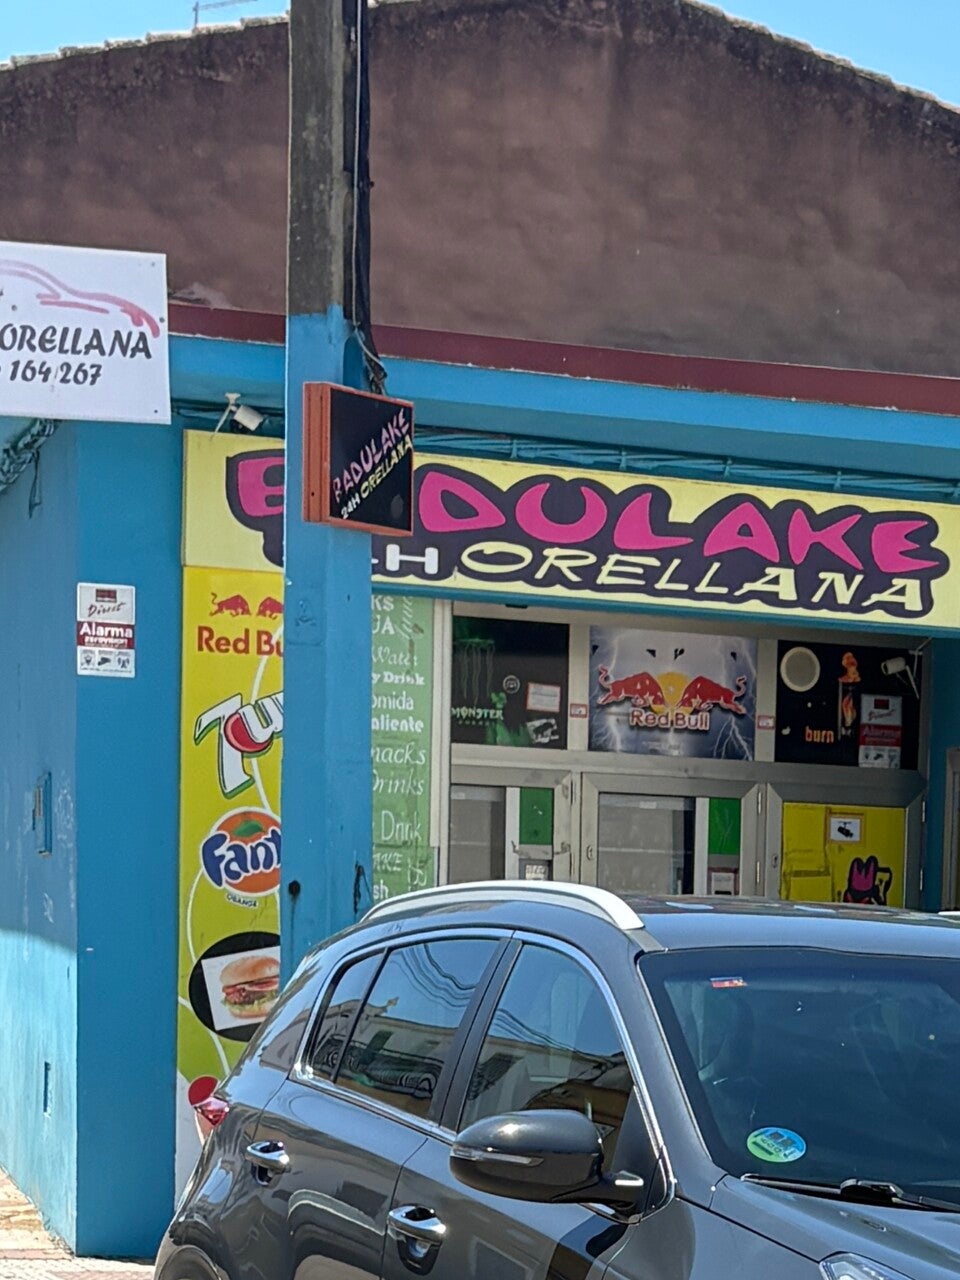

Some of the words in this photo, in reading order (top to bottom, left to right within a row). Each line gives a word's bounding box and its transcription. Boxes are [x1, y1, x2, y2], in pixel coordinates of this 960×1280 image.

[0, 323, 152, 359] ORELLANA
[10, 360, 52, 383] 164
[59, 362, 102, 385] 267
[341, 493, 360, 519] 24H
[360, 434, 413, 499] ORELLANA
[236, 456, 941, 573] BDULAKE
[460, 541, 922, 611] ORELLANA
[80, 622, 133, 638] Alarma
[197, 626, 250, 654] Red
[383, 671, 425, 685] Drink
[371, 691, 414, 710] omida
[371, 714, 424, 732] aliente
[630, 709, 669, 727] Red
[674, 711, 710, 729] Bull
[805, 725, 834, 743] burn
[371, 742, 426, 765] nacks
[202, 828, 281, 887] Fant
